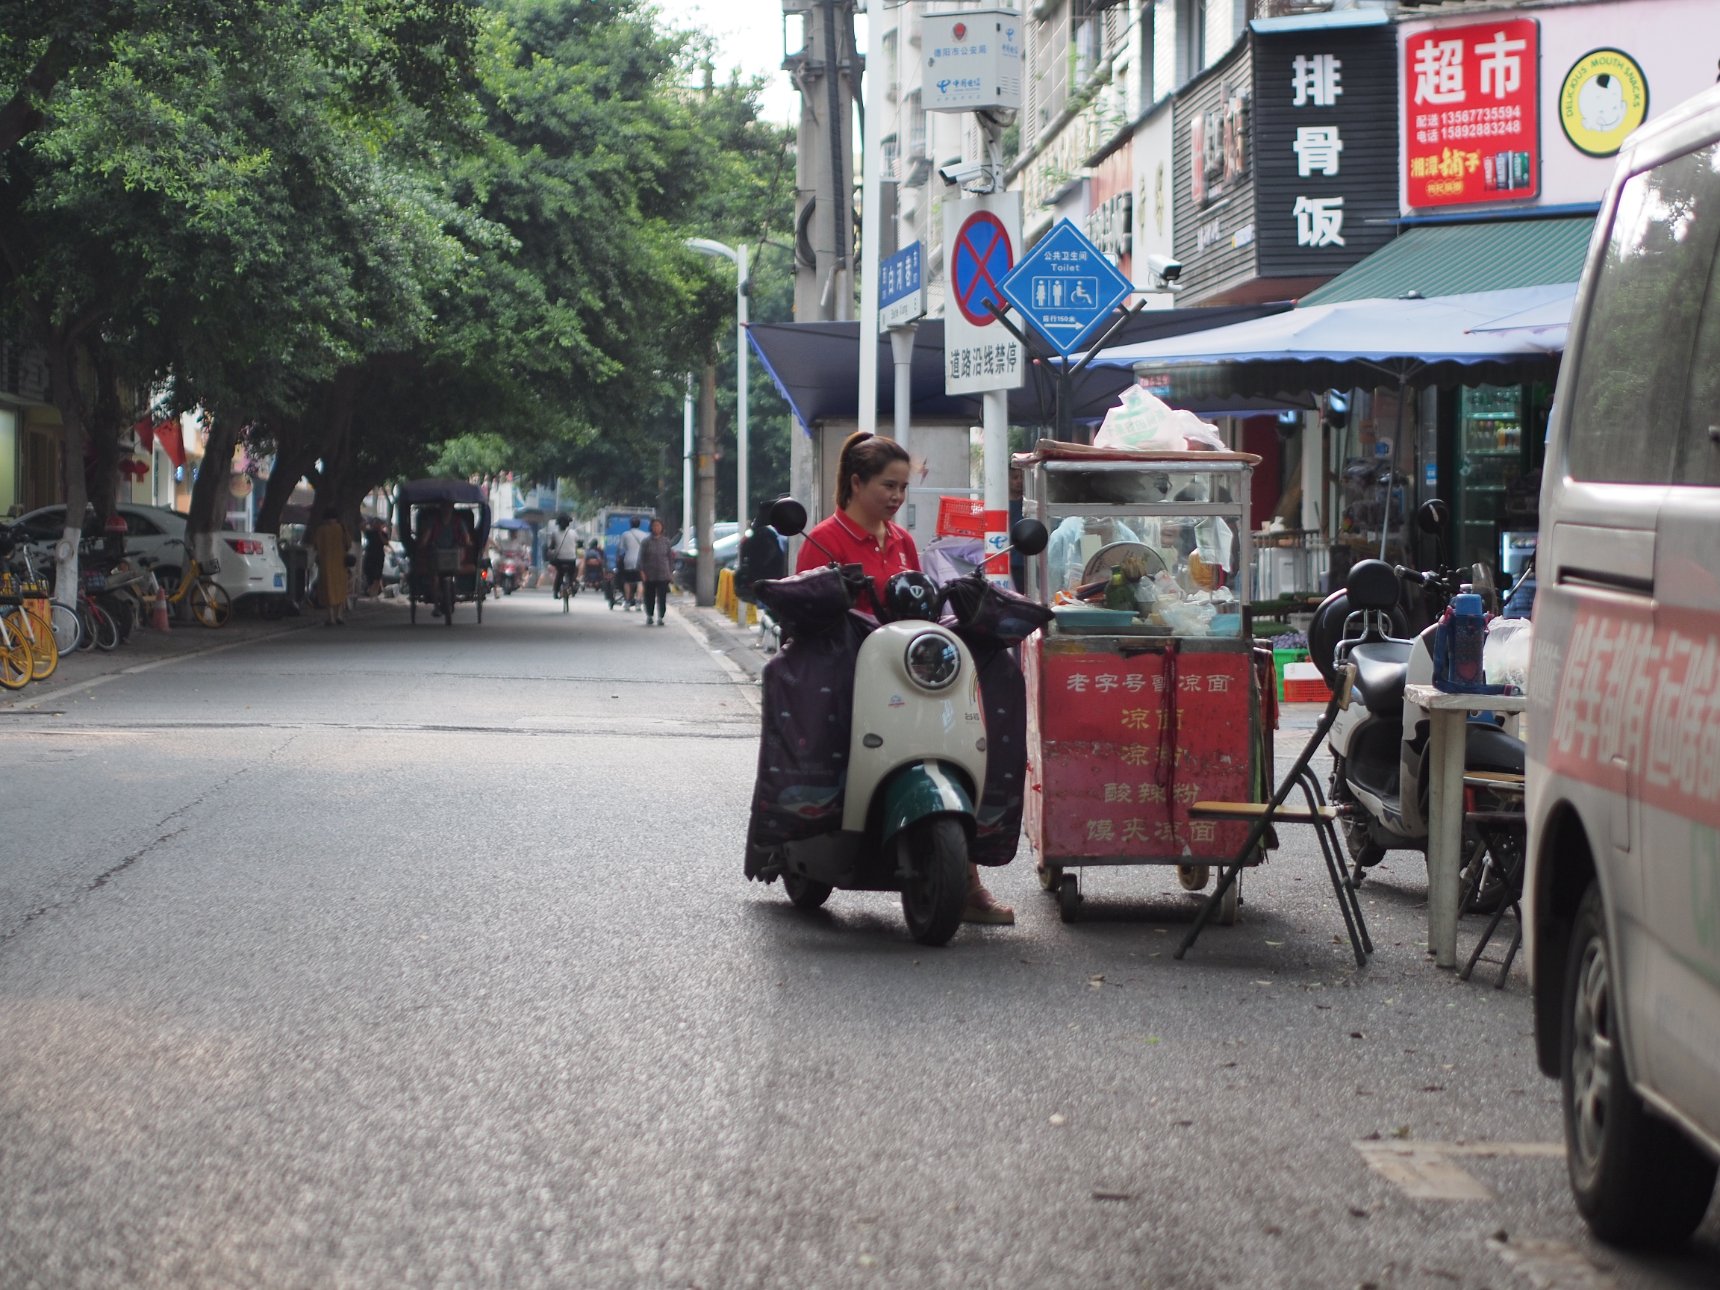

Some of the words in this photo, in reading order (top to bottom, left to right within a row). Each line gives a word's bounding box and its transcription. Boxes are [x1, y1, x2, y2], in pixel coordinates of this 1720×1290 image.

[1414, 31, 1526, 106] 超市
[1566, 66, 1588, 118] DELICIOUS
[1590, 56, 1625, 71] MOUTH
[1623, 66, 1641, 108] SNACKS
[1416, 114, 1439, 129] 配送
[1416, 128, 1439, 143] 电话
[1441, 119, 1521, 140] 15892883248
[1292, 54, 1346, 248] 排骨饭
[1044, 251, 1088, 261] 公共卫生间
[1051, 263, 1080, 272] Toilet
[950, 341, 1017, 379] 道路沿线禁停
[1104, 782, 1200, 804] 酸辣粉
